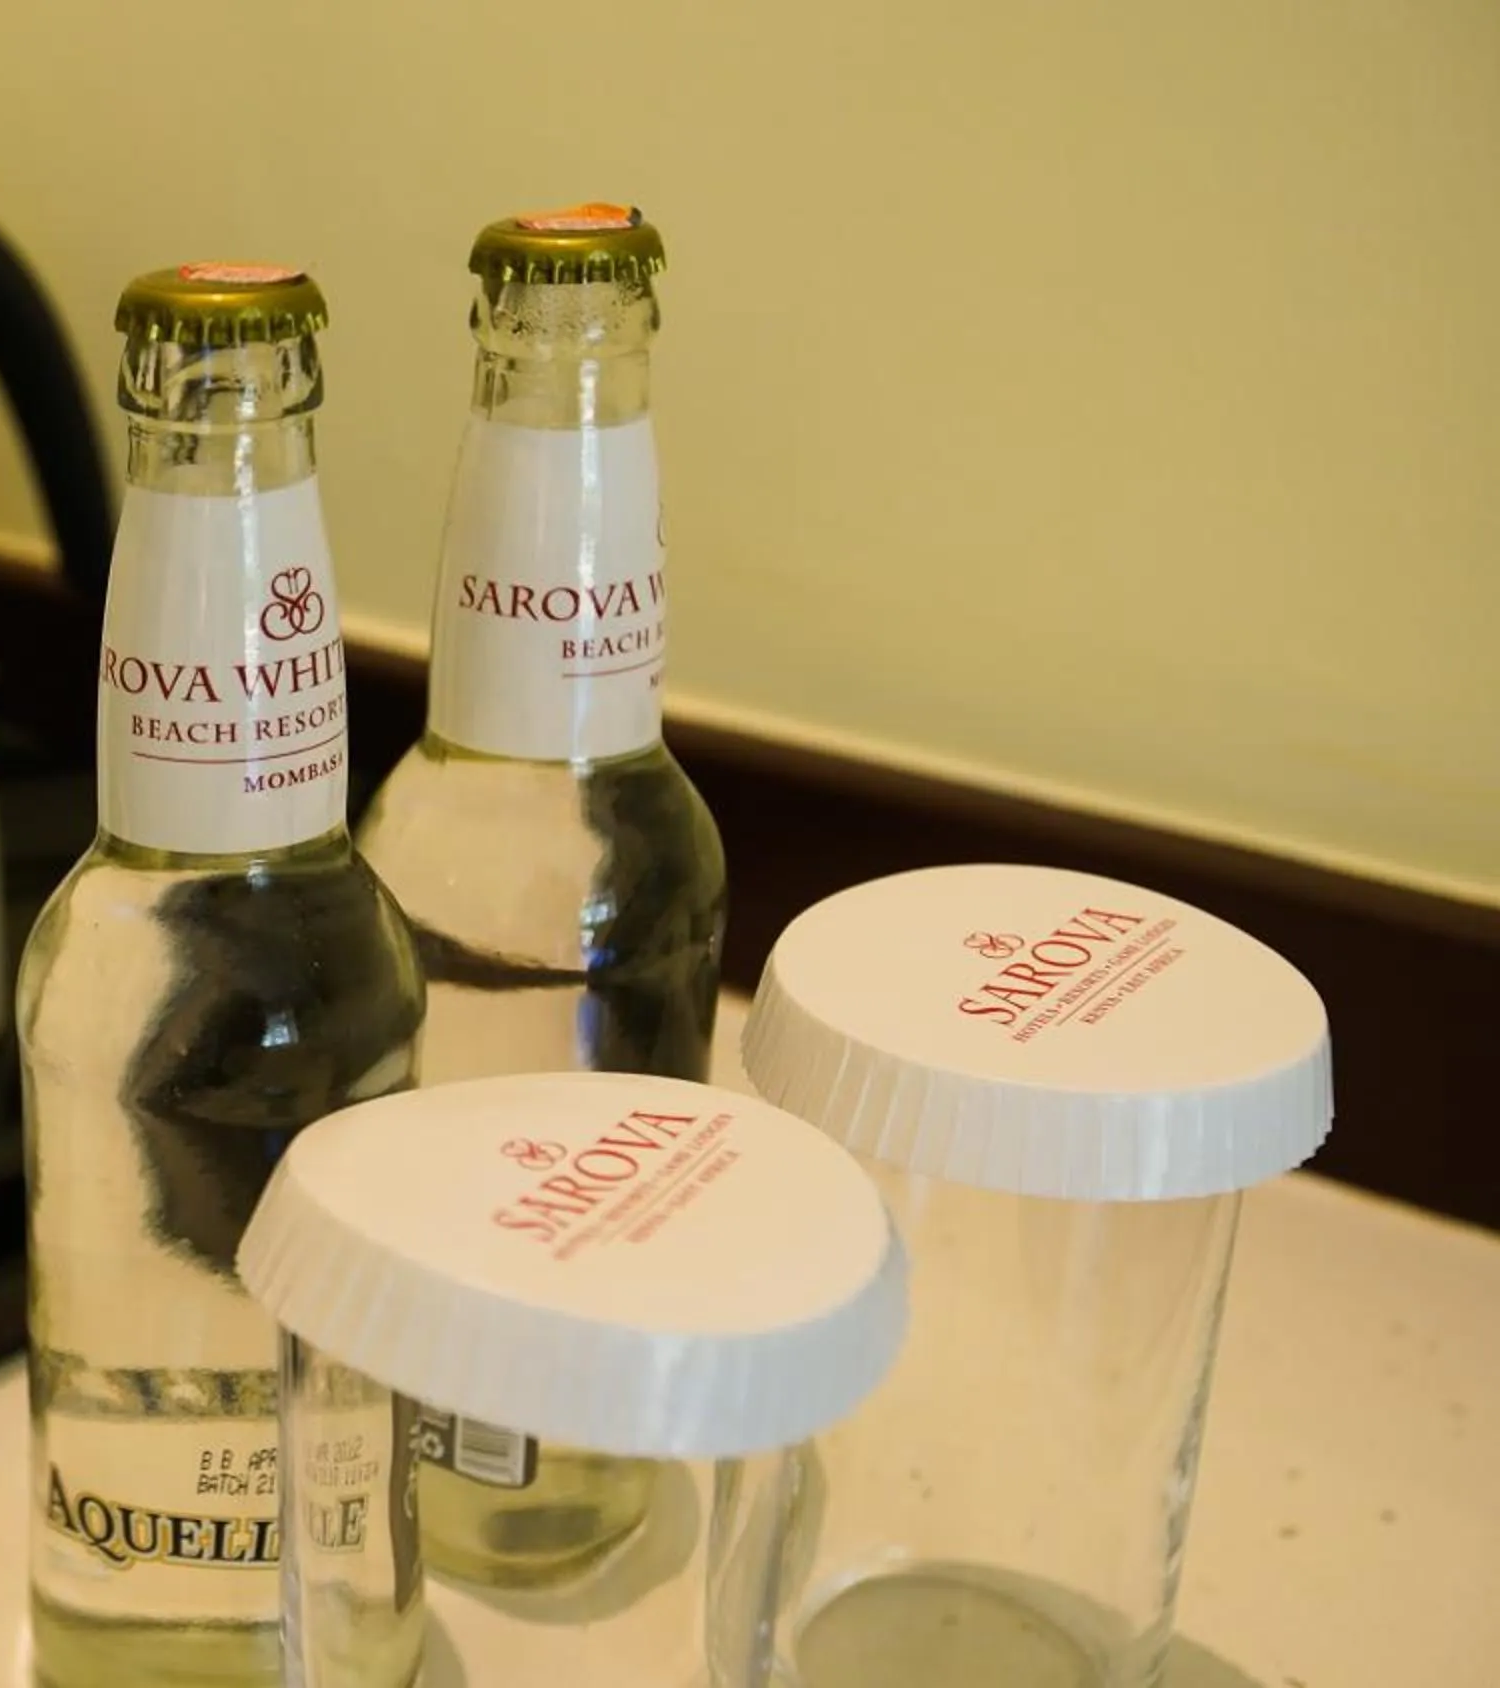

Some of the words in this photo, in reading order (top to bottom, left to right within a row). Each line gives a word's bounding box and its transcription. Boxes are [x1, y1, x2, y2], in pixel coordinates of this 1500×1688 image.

[459, 573, 641, 622] SAROVA
[562, 627, 650, 661] BEACH
[131, 713, 238, 745] BEACH
[958, 907, 1145, 1027] SAROVA
[491, 1111, 698, 1244] SAROVA
[200, 1449, 213, 1471] B
[220, 1448, 234, 1470] B
[196, 1473, 249, 1496] BATCH
